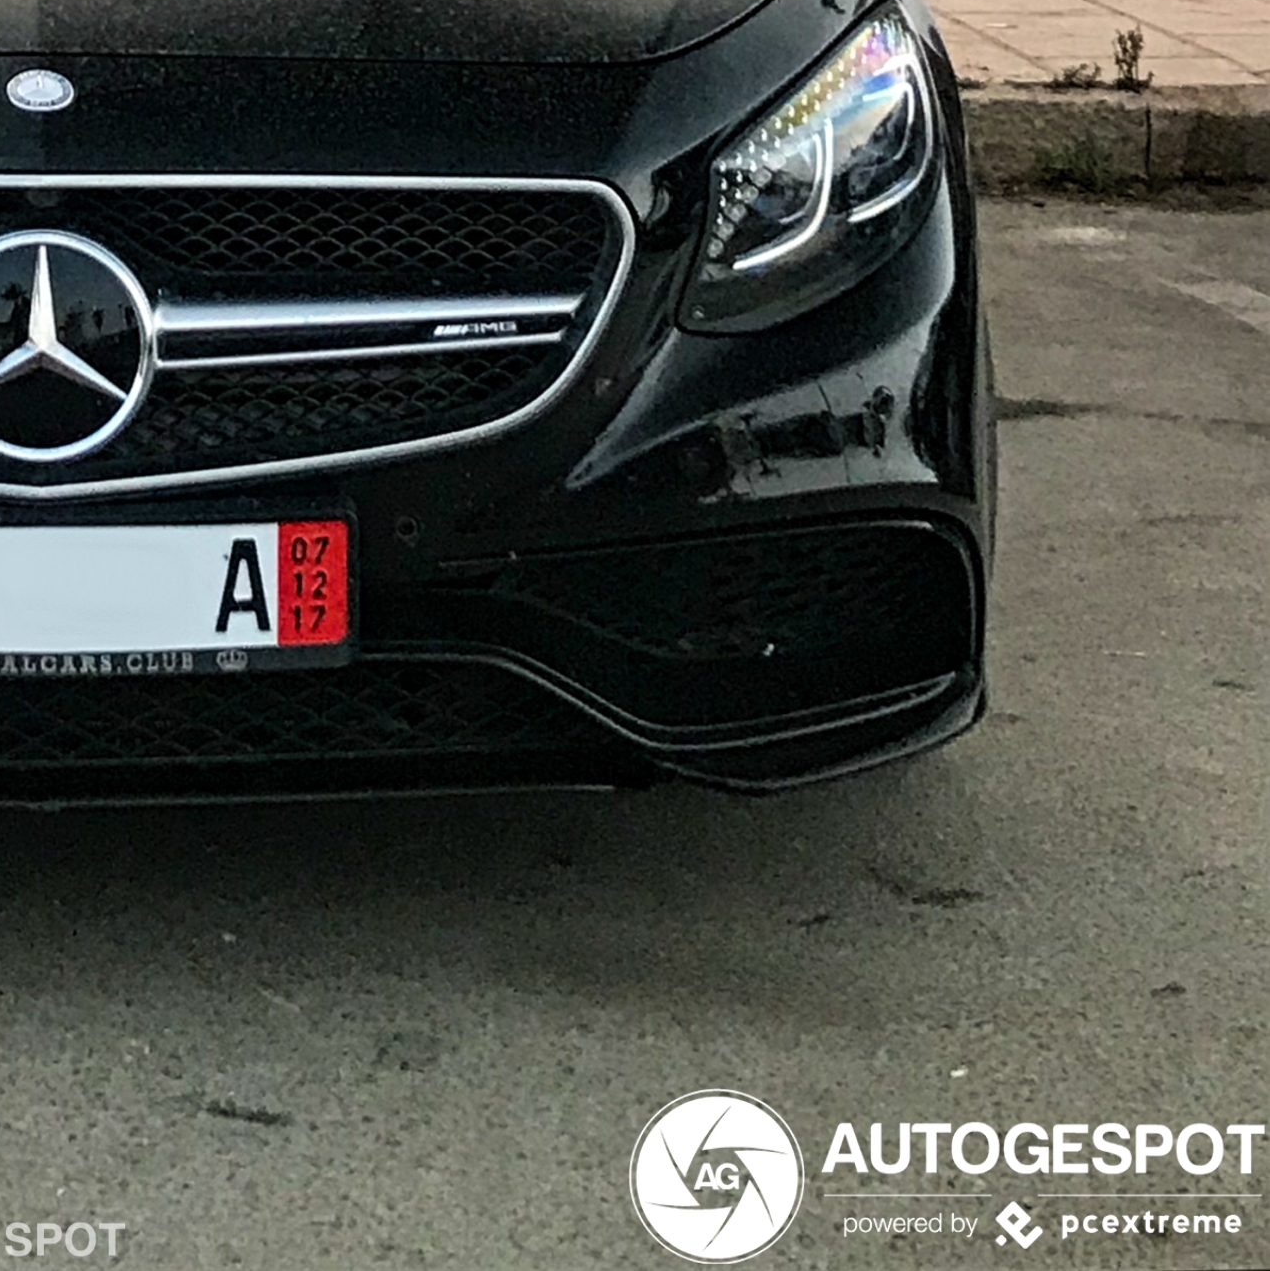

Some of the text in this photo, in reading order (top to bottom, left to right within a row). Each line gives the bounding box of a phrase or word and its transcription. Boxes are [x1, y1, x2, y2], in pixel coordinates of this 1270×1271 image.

[291, 536, 329, 563] 07
[215, 538, 270, 632] A
[292, 572, 329, 597] 12
[290, 605, 327, 636] 17
